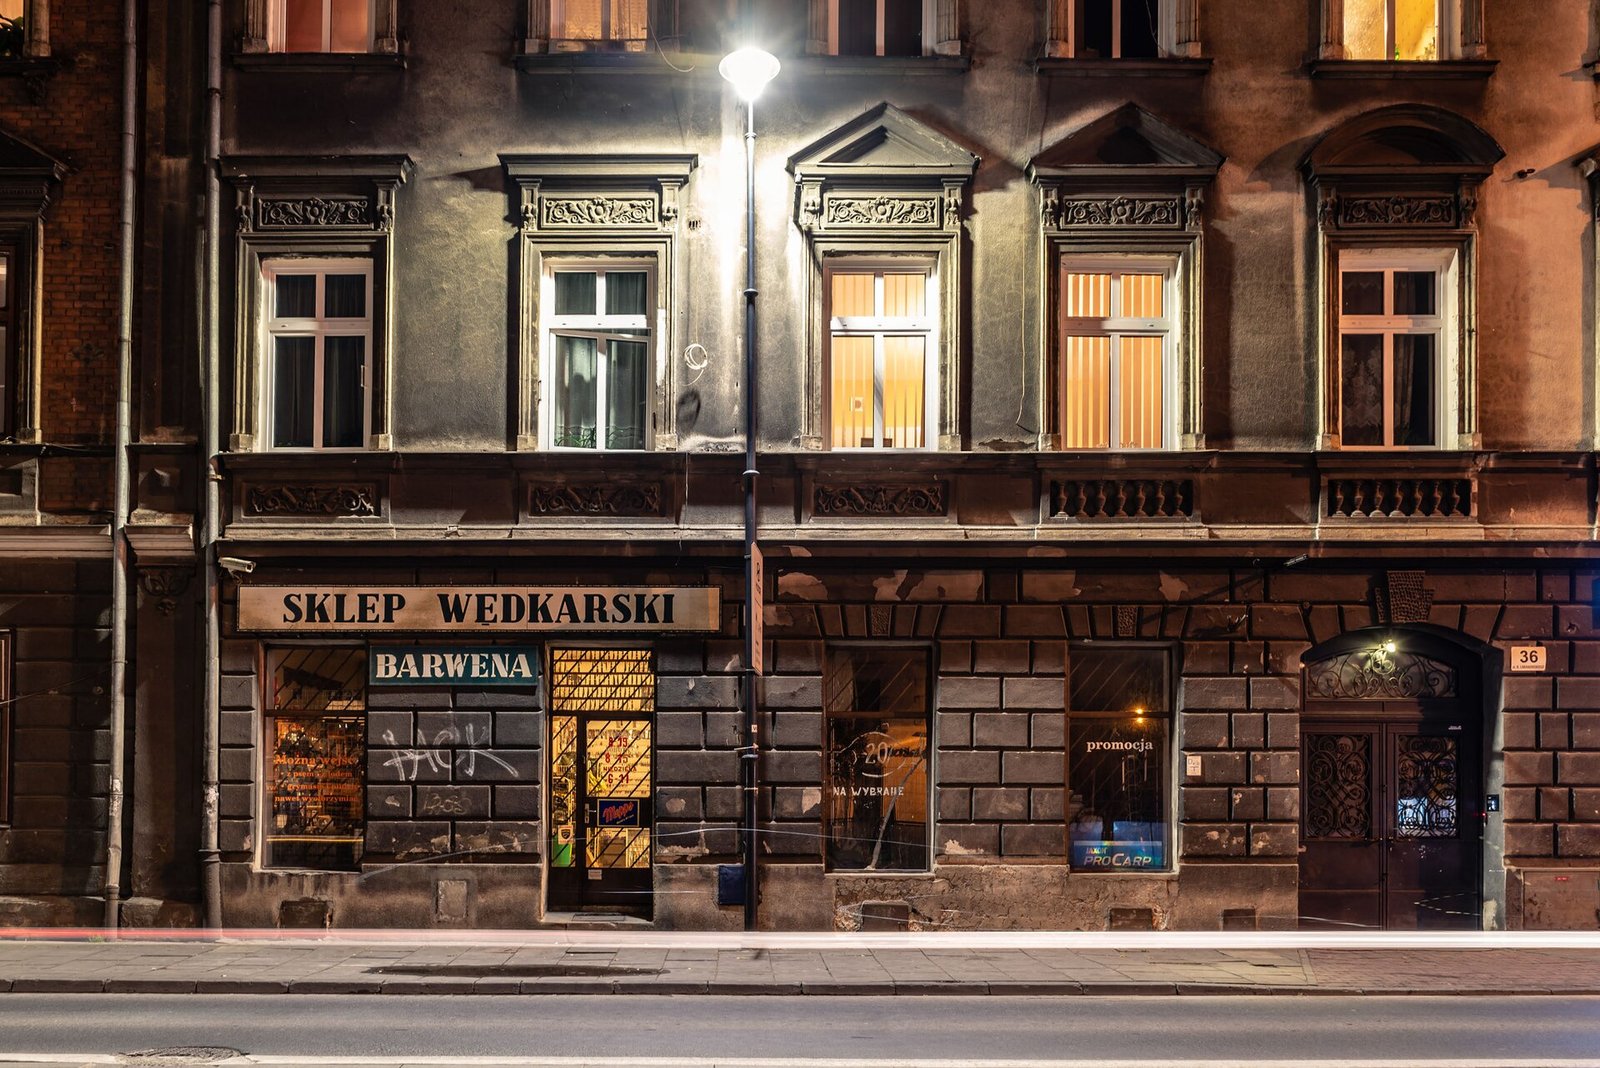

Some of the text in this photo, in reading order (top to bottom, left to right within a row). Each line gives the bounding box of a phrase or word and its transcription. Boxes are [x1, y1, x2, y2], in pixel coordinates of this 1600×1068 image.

[283, 593, 675, 626] SKLEP WĘDKARSKI
[1520, 650, 1538, 663] 36
[376, 654, 532, 678] BARWENA
[1086, 738, 1153, 752] promocja
[833, 786, 847, 796] NA
